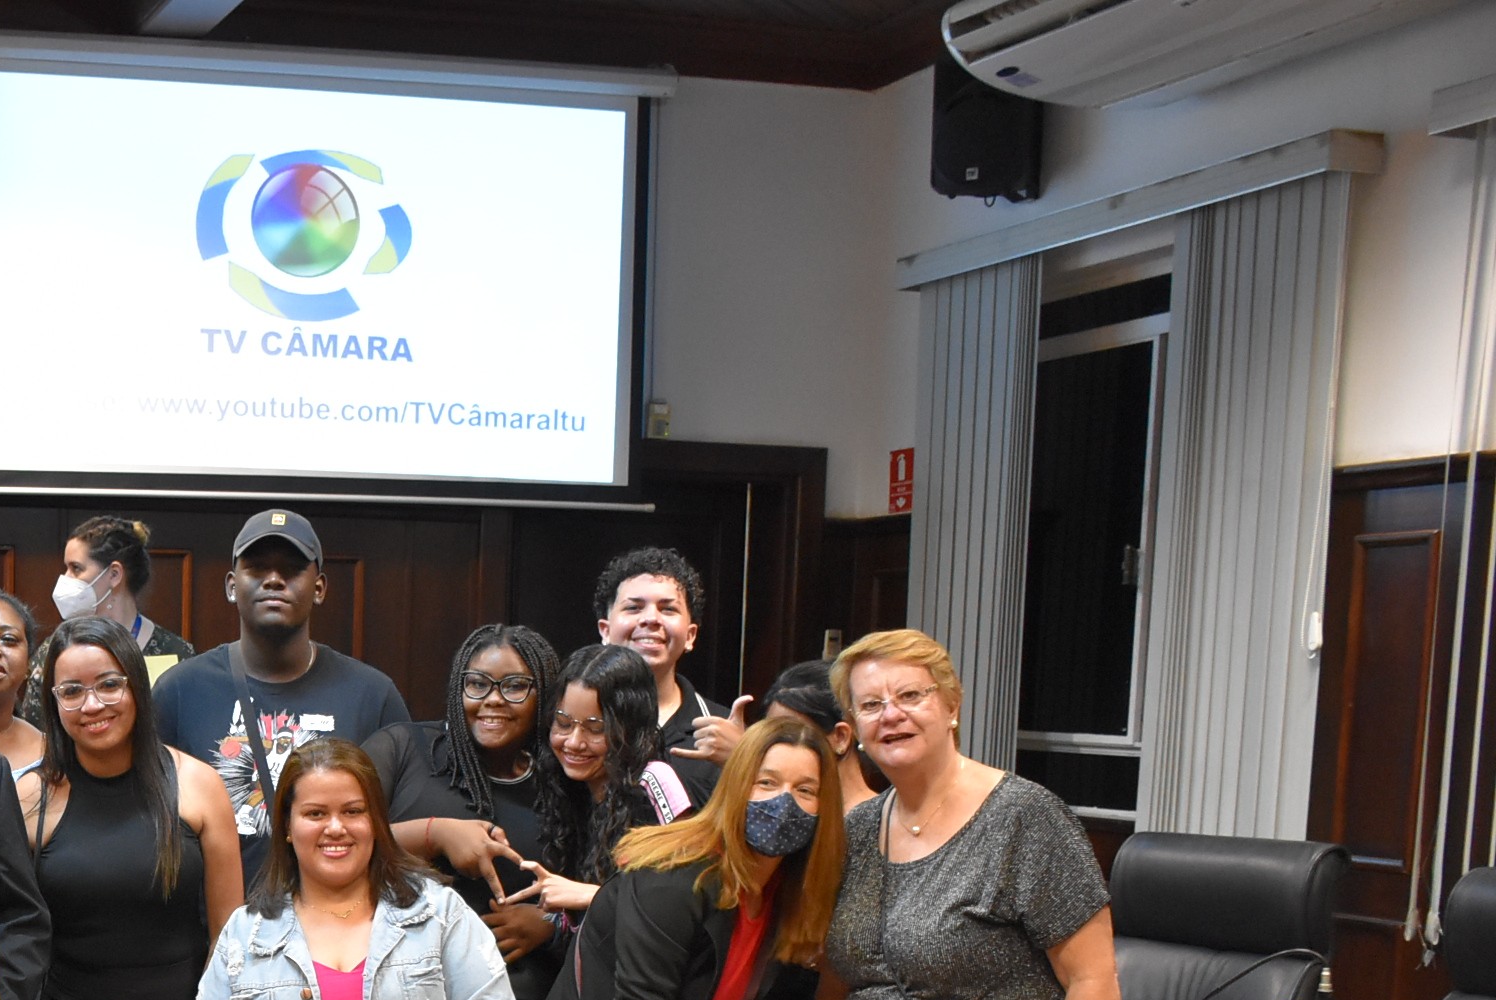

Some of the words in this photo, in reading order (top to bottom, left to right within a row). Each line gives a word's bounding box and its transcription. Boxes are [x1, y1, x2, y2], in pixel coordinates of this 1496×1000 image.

[201, 329, 247, 354] TV
[261, 326, 413, 362] CÂMARA
[137, 396, 585, 432] www.youtube.com/TVCâmaraItu
